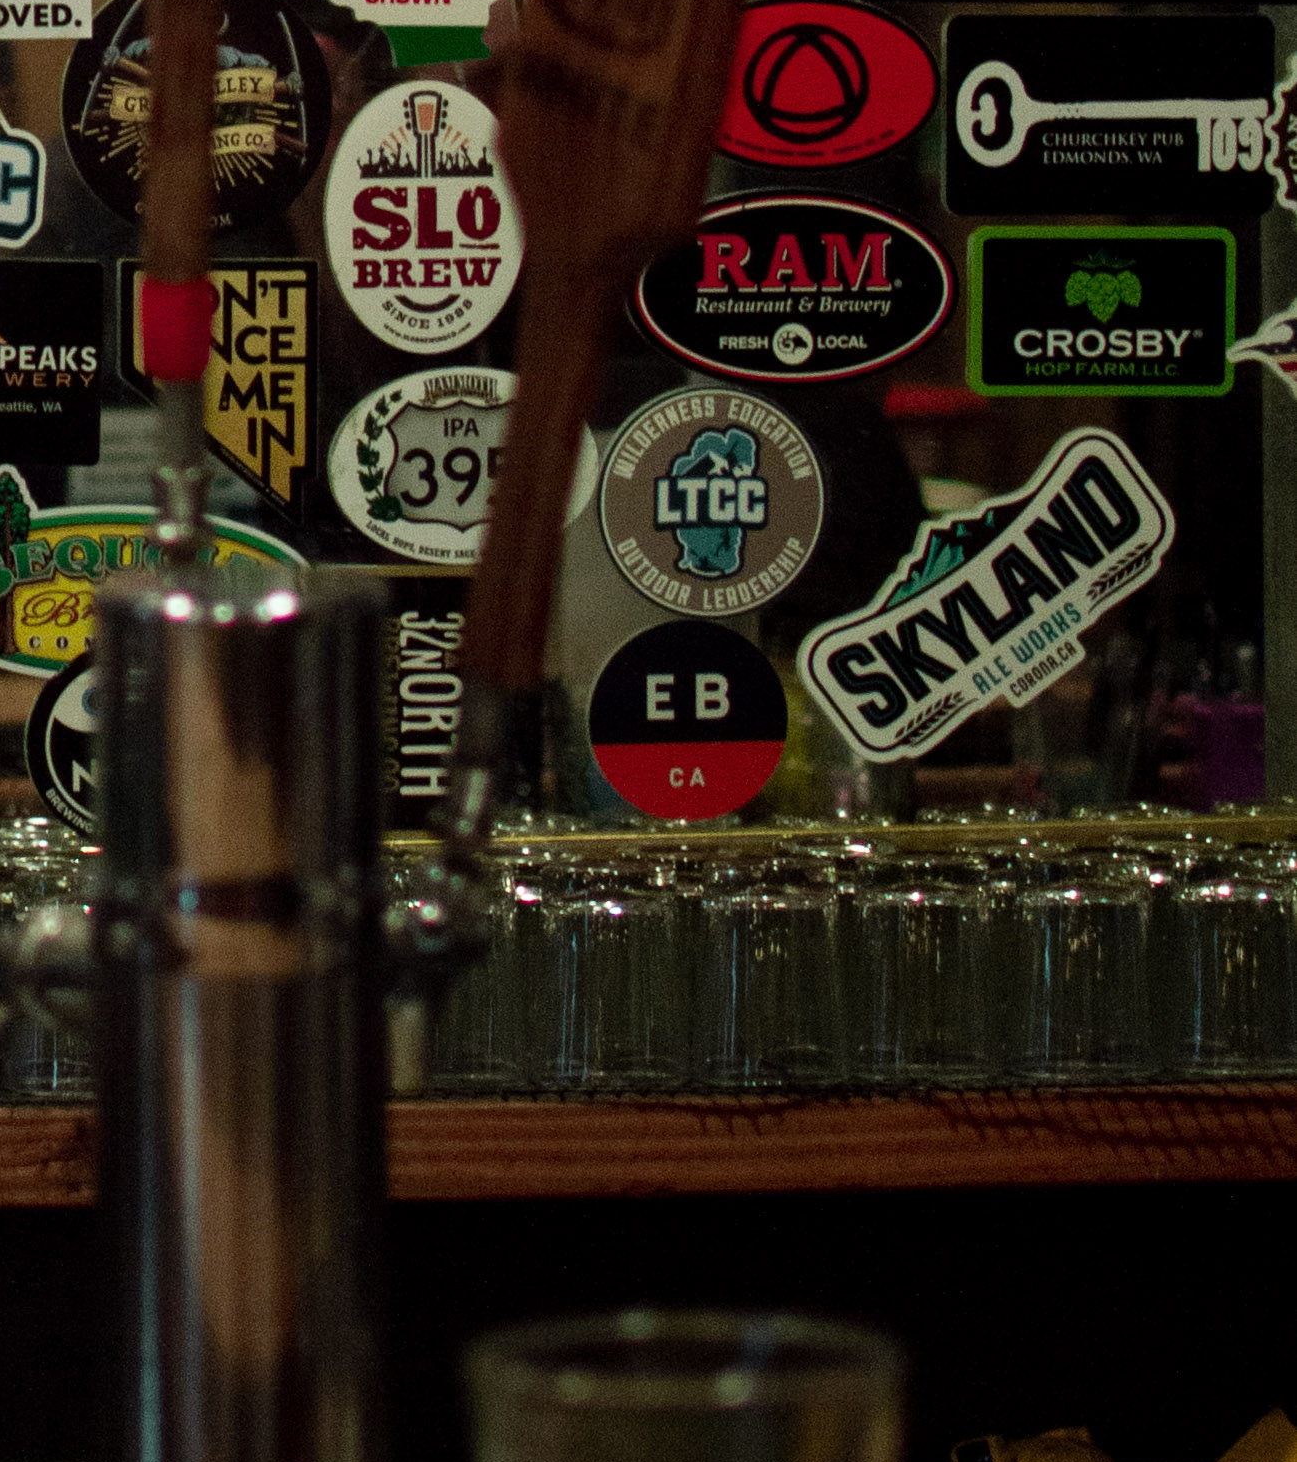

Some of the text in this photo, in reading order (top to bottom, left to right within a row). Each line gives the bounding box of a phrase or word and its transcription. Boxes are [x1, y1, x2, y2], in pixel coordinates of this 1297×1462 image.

[1042, 132, 1184, 147] CHURCHKEY PUB
[351, 186, 502, 250] SLO
[351, 259, 503, 288] BREW
[695, 232, 892, 293] RAM
[694, 296, 794, 316] Restaurant
[818, 295, 892, 317] Brewery
[718, 334, 769, 351] FRESH
[817, 333, 867, 349] LOCAL
[1013, 330, 1191, 358] CROSBY
[654, 480, 767, 522] LTCC
[826, 455, 1143, 729] SKYLAND
